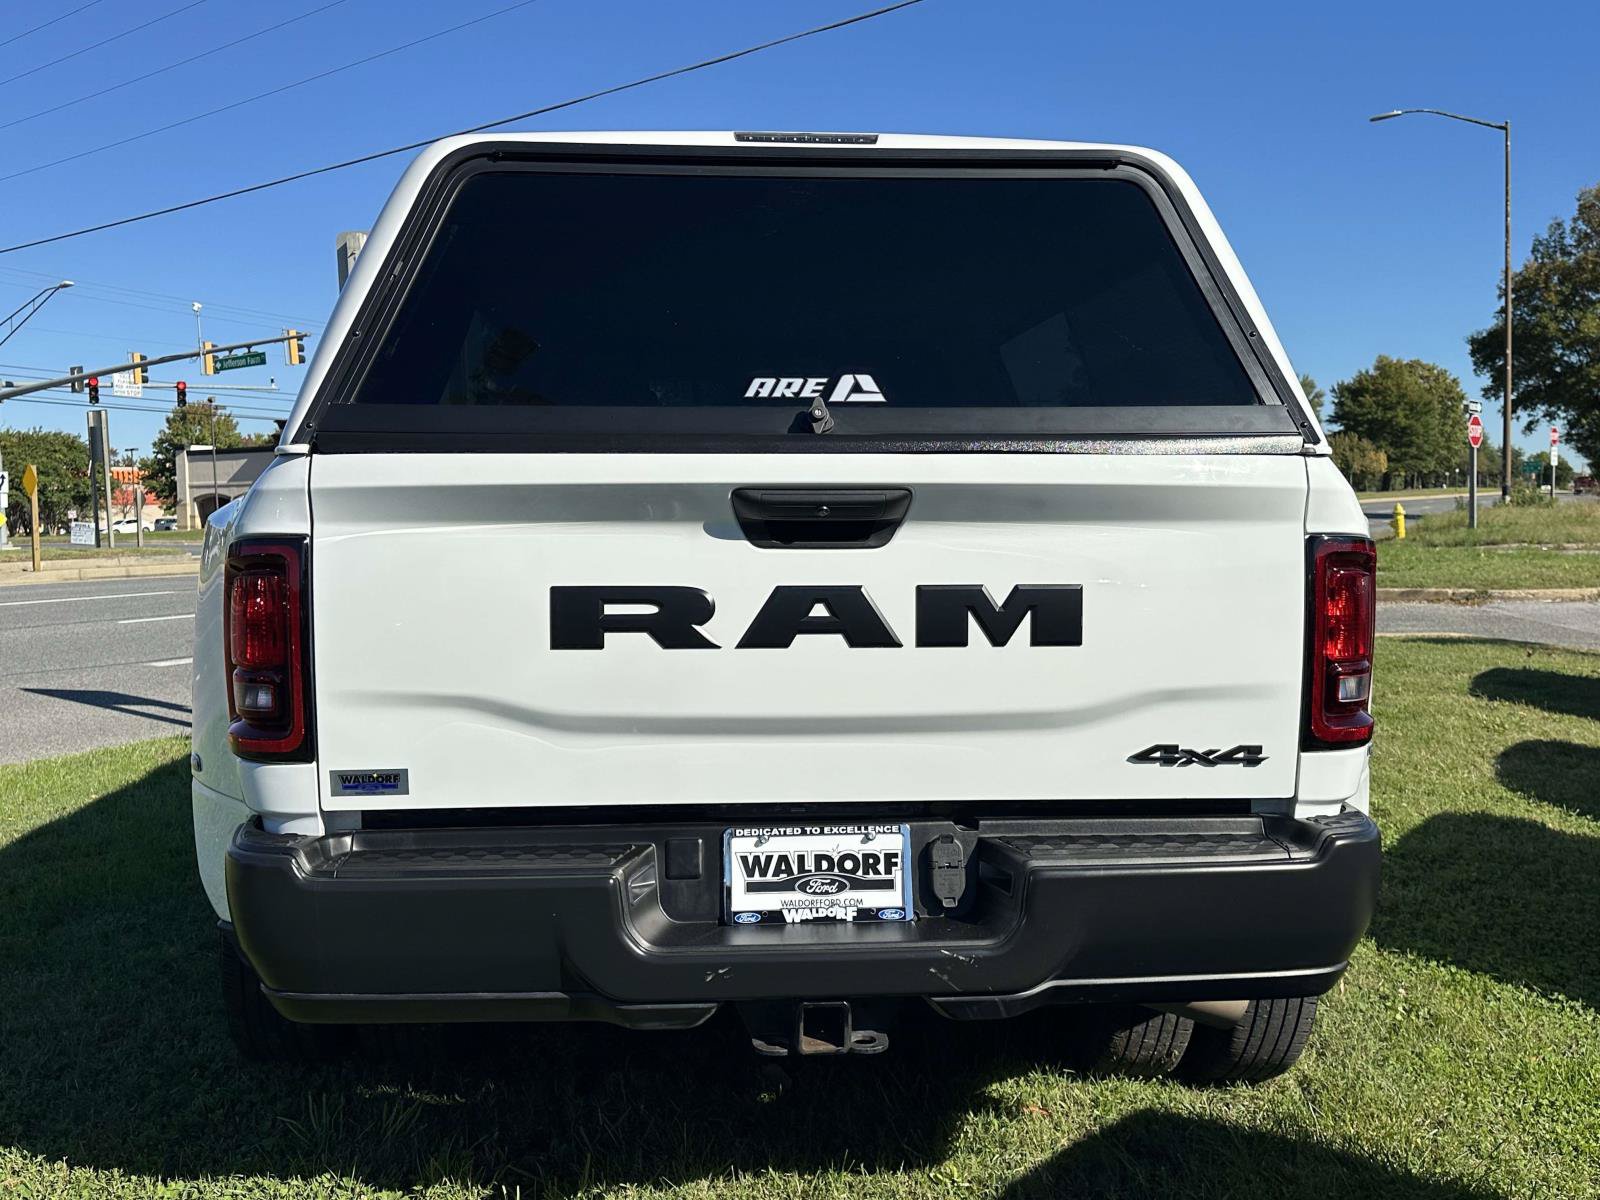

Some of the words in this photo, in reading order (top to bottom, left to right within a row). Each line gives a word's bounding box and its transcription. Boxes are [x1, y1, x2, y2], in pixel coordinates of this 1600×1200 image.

[223, 358, 247, 369] Jefferson
[247, 355, 262, 365] Farm
[744, 377, 830, 398] ARE
[1470, 425, 1482, 437] STOP
[550, 584, 1082, 650] RAM
[339, 773, 400, 784] WALDORF
[735, 827, 801, 837] DEDICATED
[805, 826, 820, 835] TO
[824, 825, 900, 834] EXCELLENCE
[739, 852, 899, 878] WALDORF
[806, 879, 839, 893] Ford
[780, 898, 864, 908] WALDORFFORD.COM
[736, 912, 760, 923] Ford
[781, 906, 858, 924] WALDORF
[880, 909, 903, 920] Ford
